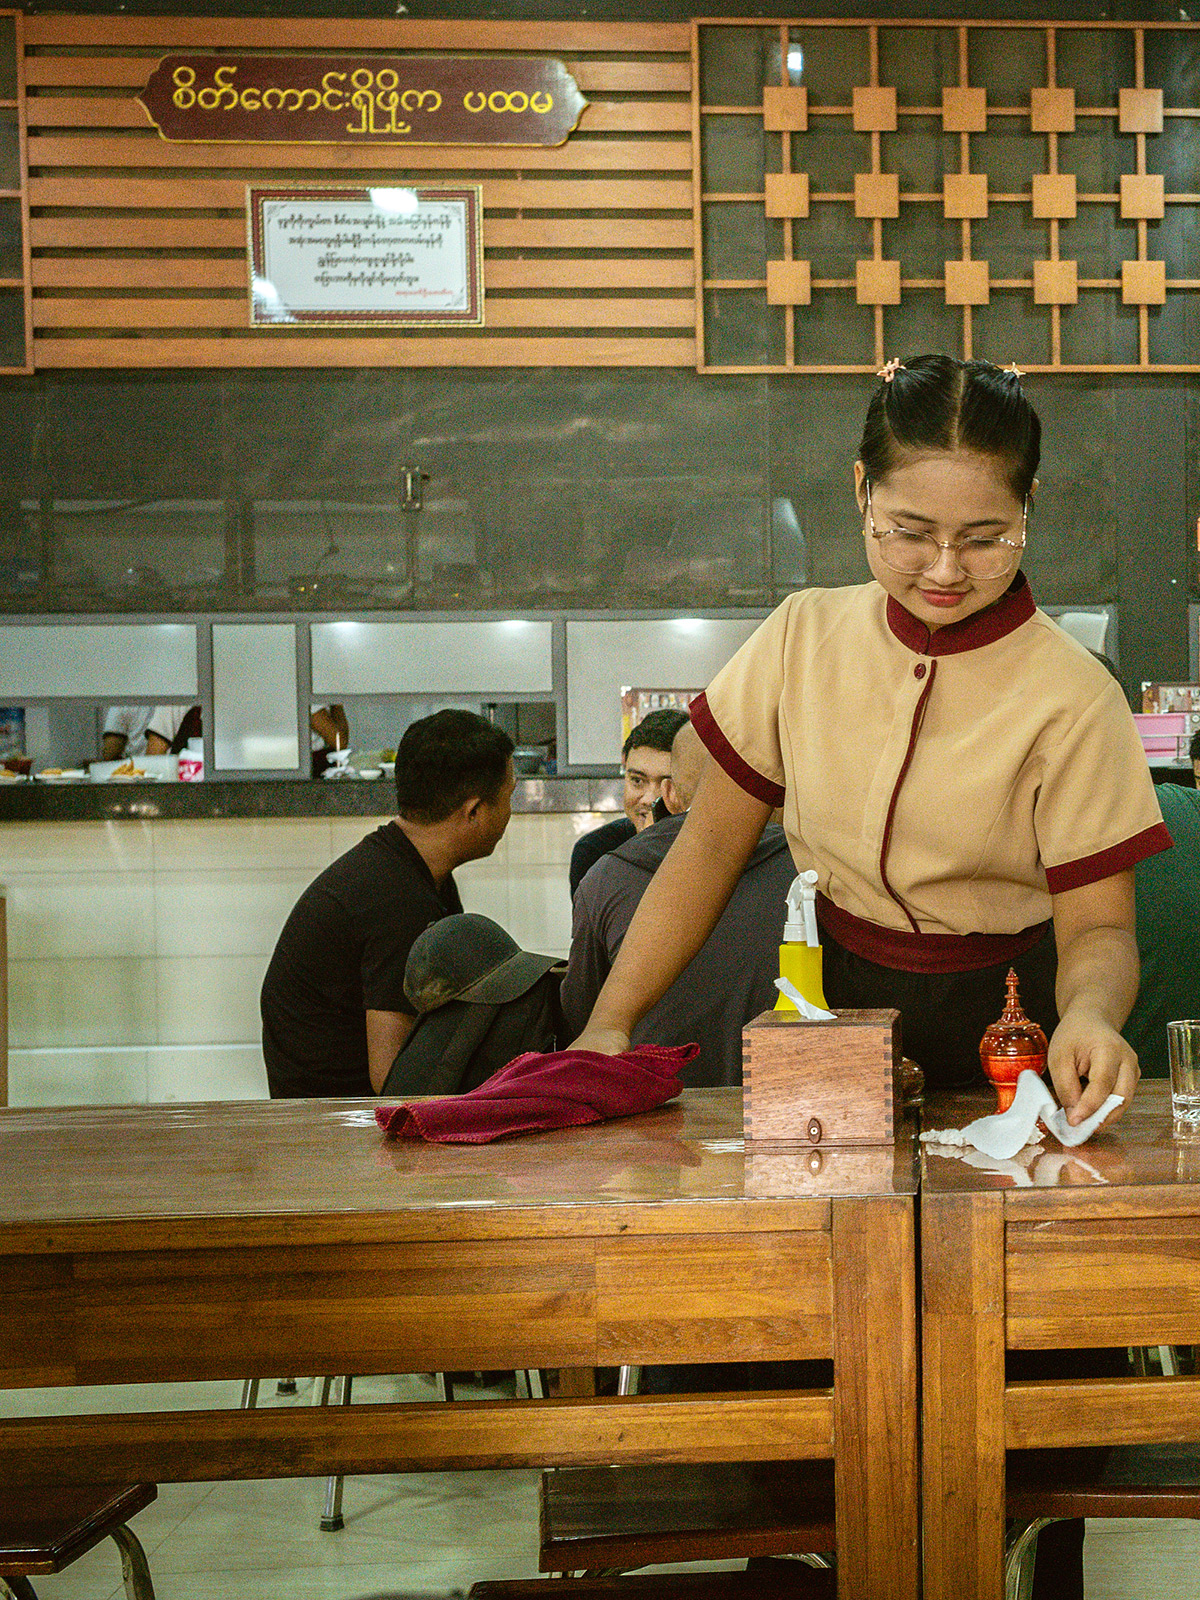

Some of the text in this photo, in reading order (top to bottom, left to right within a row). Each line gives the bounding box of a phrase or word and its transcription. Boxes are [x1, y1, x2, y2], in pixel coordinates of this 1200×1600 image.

[173, 67, 553, 134] စိတ်ကောင်းရှိဖို့က ပထမ
